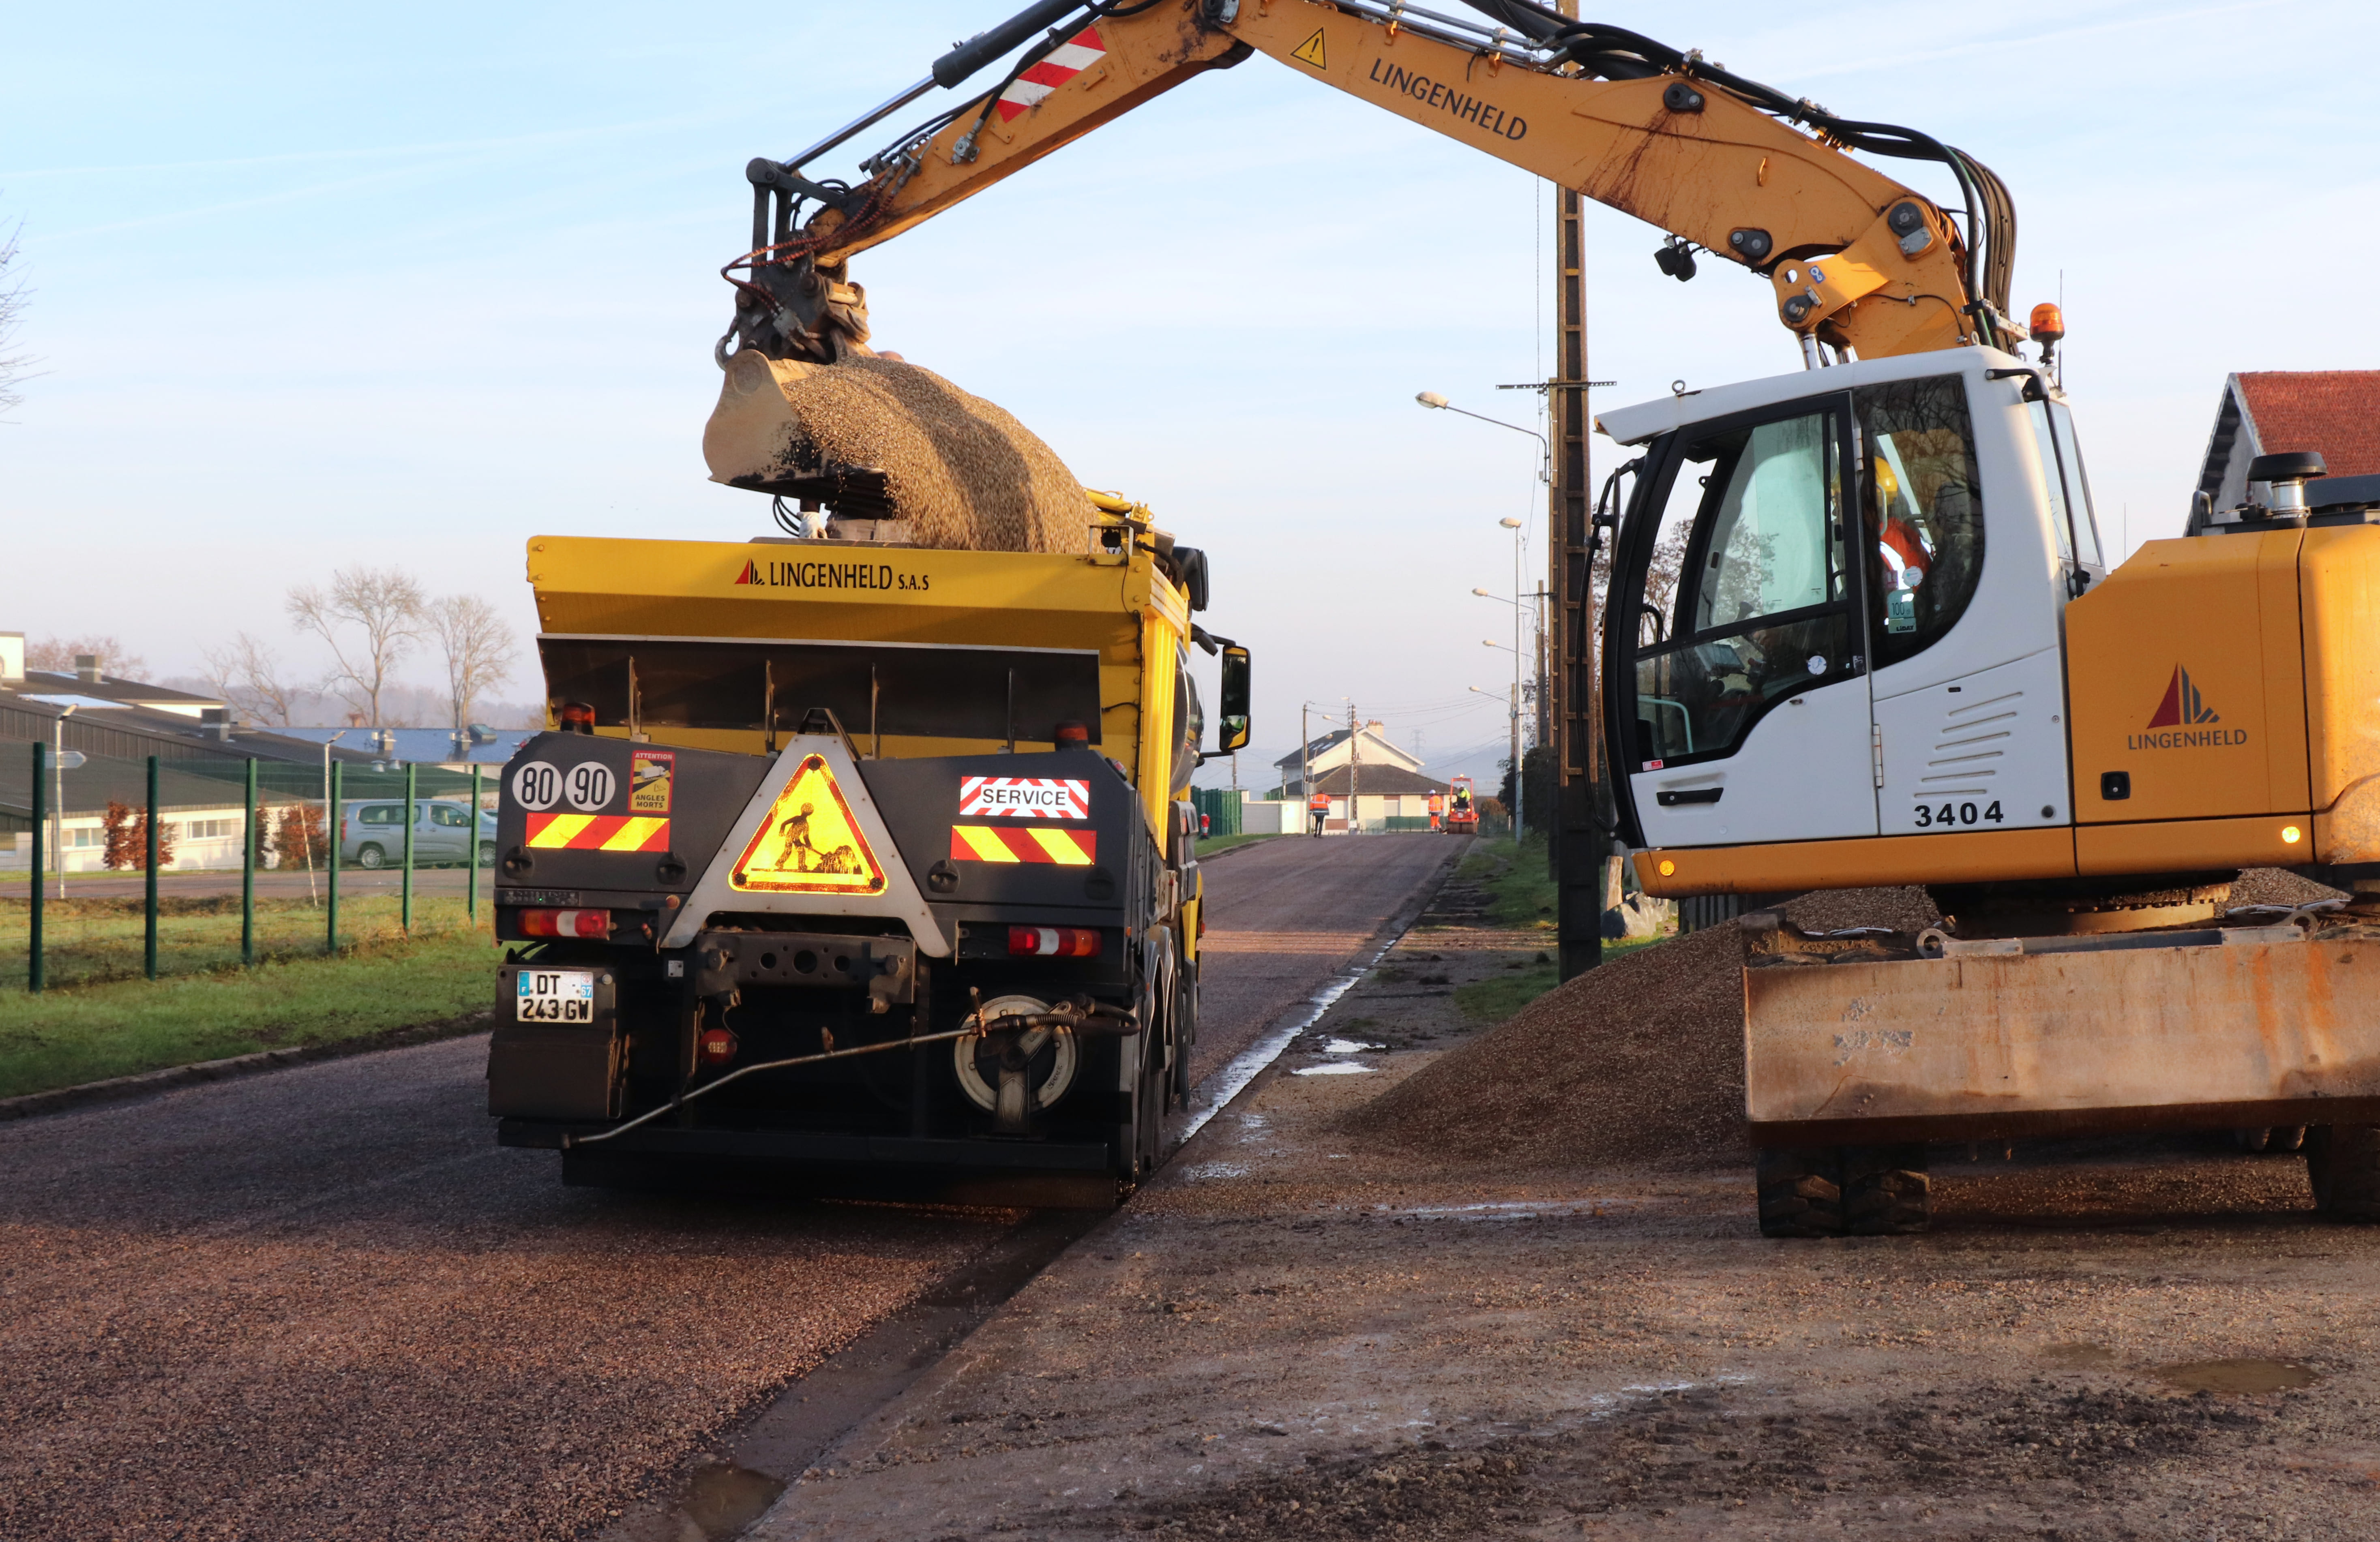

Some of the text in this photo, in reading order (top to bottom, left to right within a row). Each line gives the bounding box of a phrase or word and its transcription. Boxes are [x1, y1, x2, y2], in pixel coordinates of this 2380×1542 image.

[1369, 58, 1527, 140] LINGENHELD
[770, 562, 893, 590] LINGENHELD
[1892, 602, 1905, 615] 100
[2128, 729, 2247, 750] LINGENHELD
[522, 767, 554, 804] 80
[574, 768, 607, 805] 90
[982, 788, 1066, 805] SERVICE
[1914, 800, 2004, 827] 3404
[581, 986, 592, 996] 67
